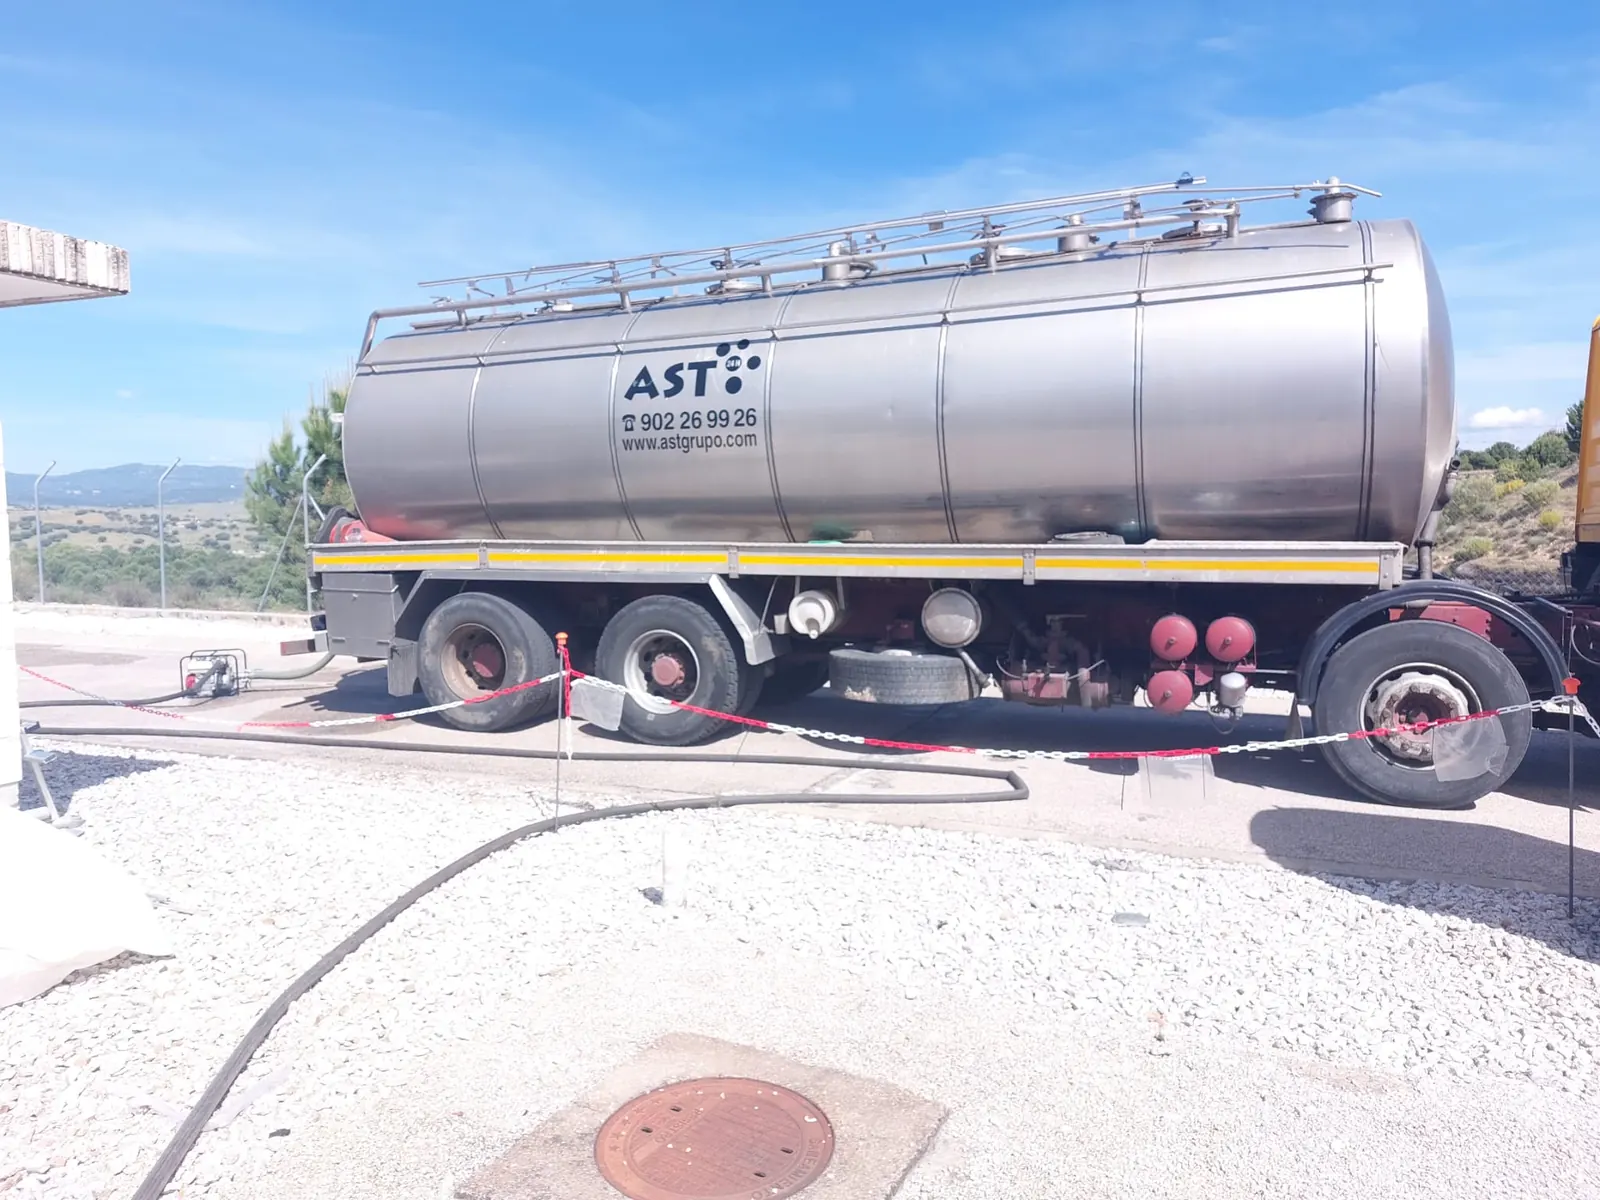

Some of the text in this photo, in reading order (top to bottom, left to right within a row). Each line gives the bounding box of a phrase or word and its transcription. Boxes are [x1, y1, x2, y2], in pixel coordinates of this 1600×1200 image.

[624, 360, 718, 400] AST
[640, 408, 757, 431] 902 26 99 26
[622, 432, 757, 454] www.astgrupo.com
